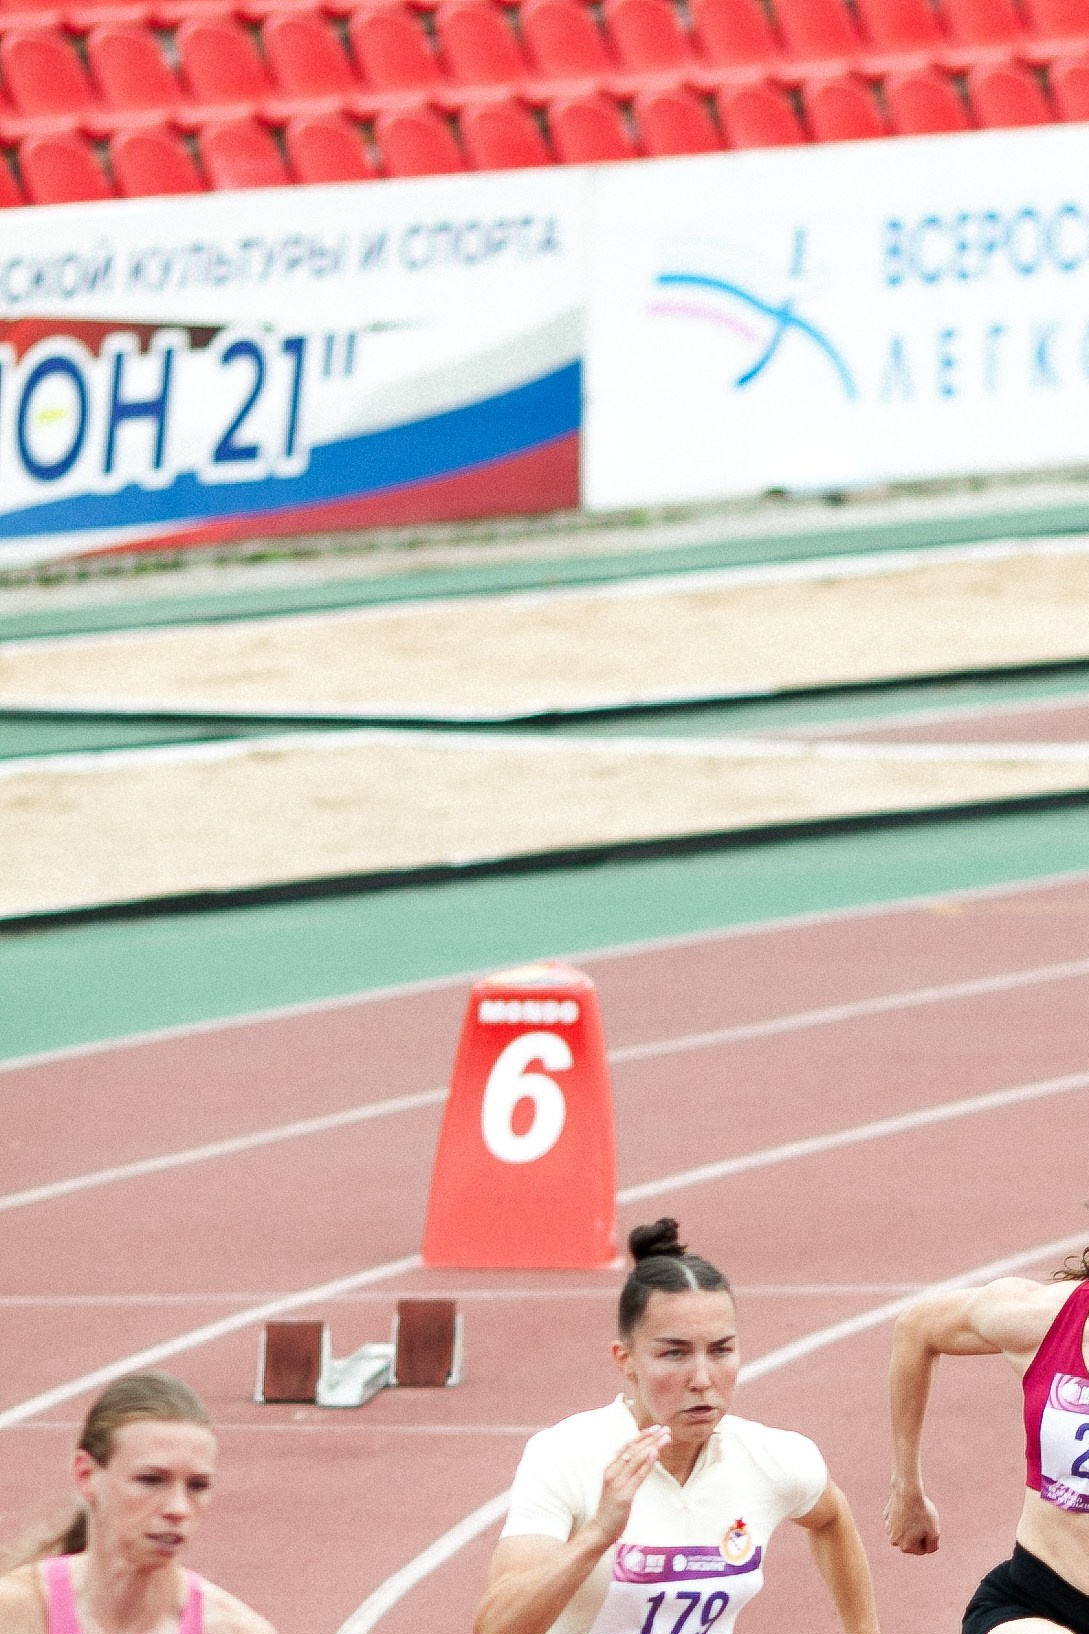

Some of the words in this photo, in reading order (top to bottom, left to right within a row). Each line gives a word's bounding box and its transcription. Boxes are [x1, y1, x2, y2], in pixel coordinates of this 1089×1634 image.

[127, 231, 346, 290] КУЛЬТУРЫ
[359, 226, 389, 272] И
[399, 214, 561, 272] СПОРТА
[0, 346, 174, 480] ОН
[481, 1031, 573, 1164] 6
